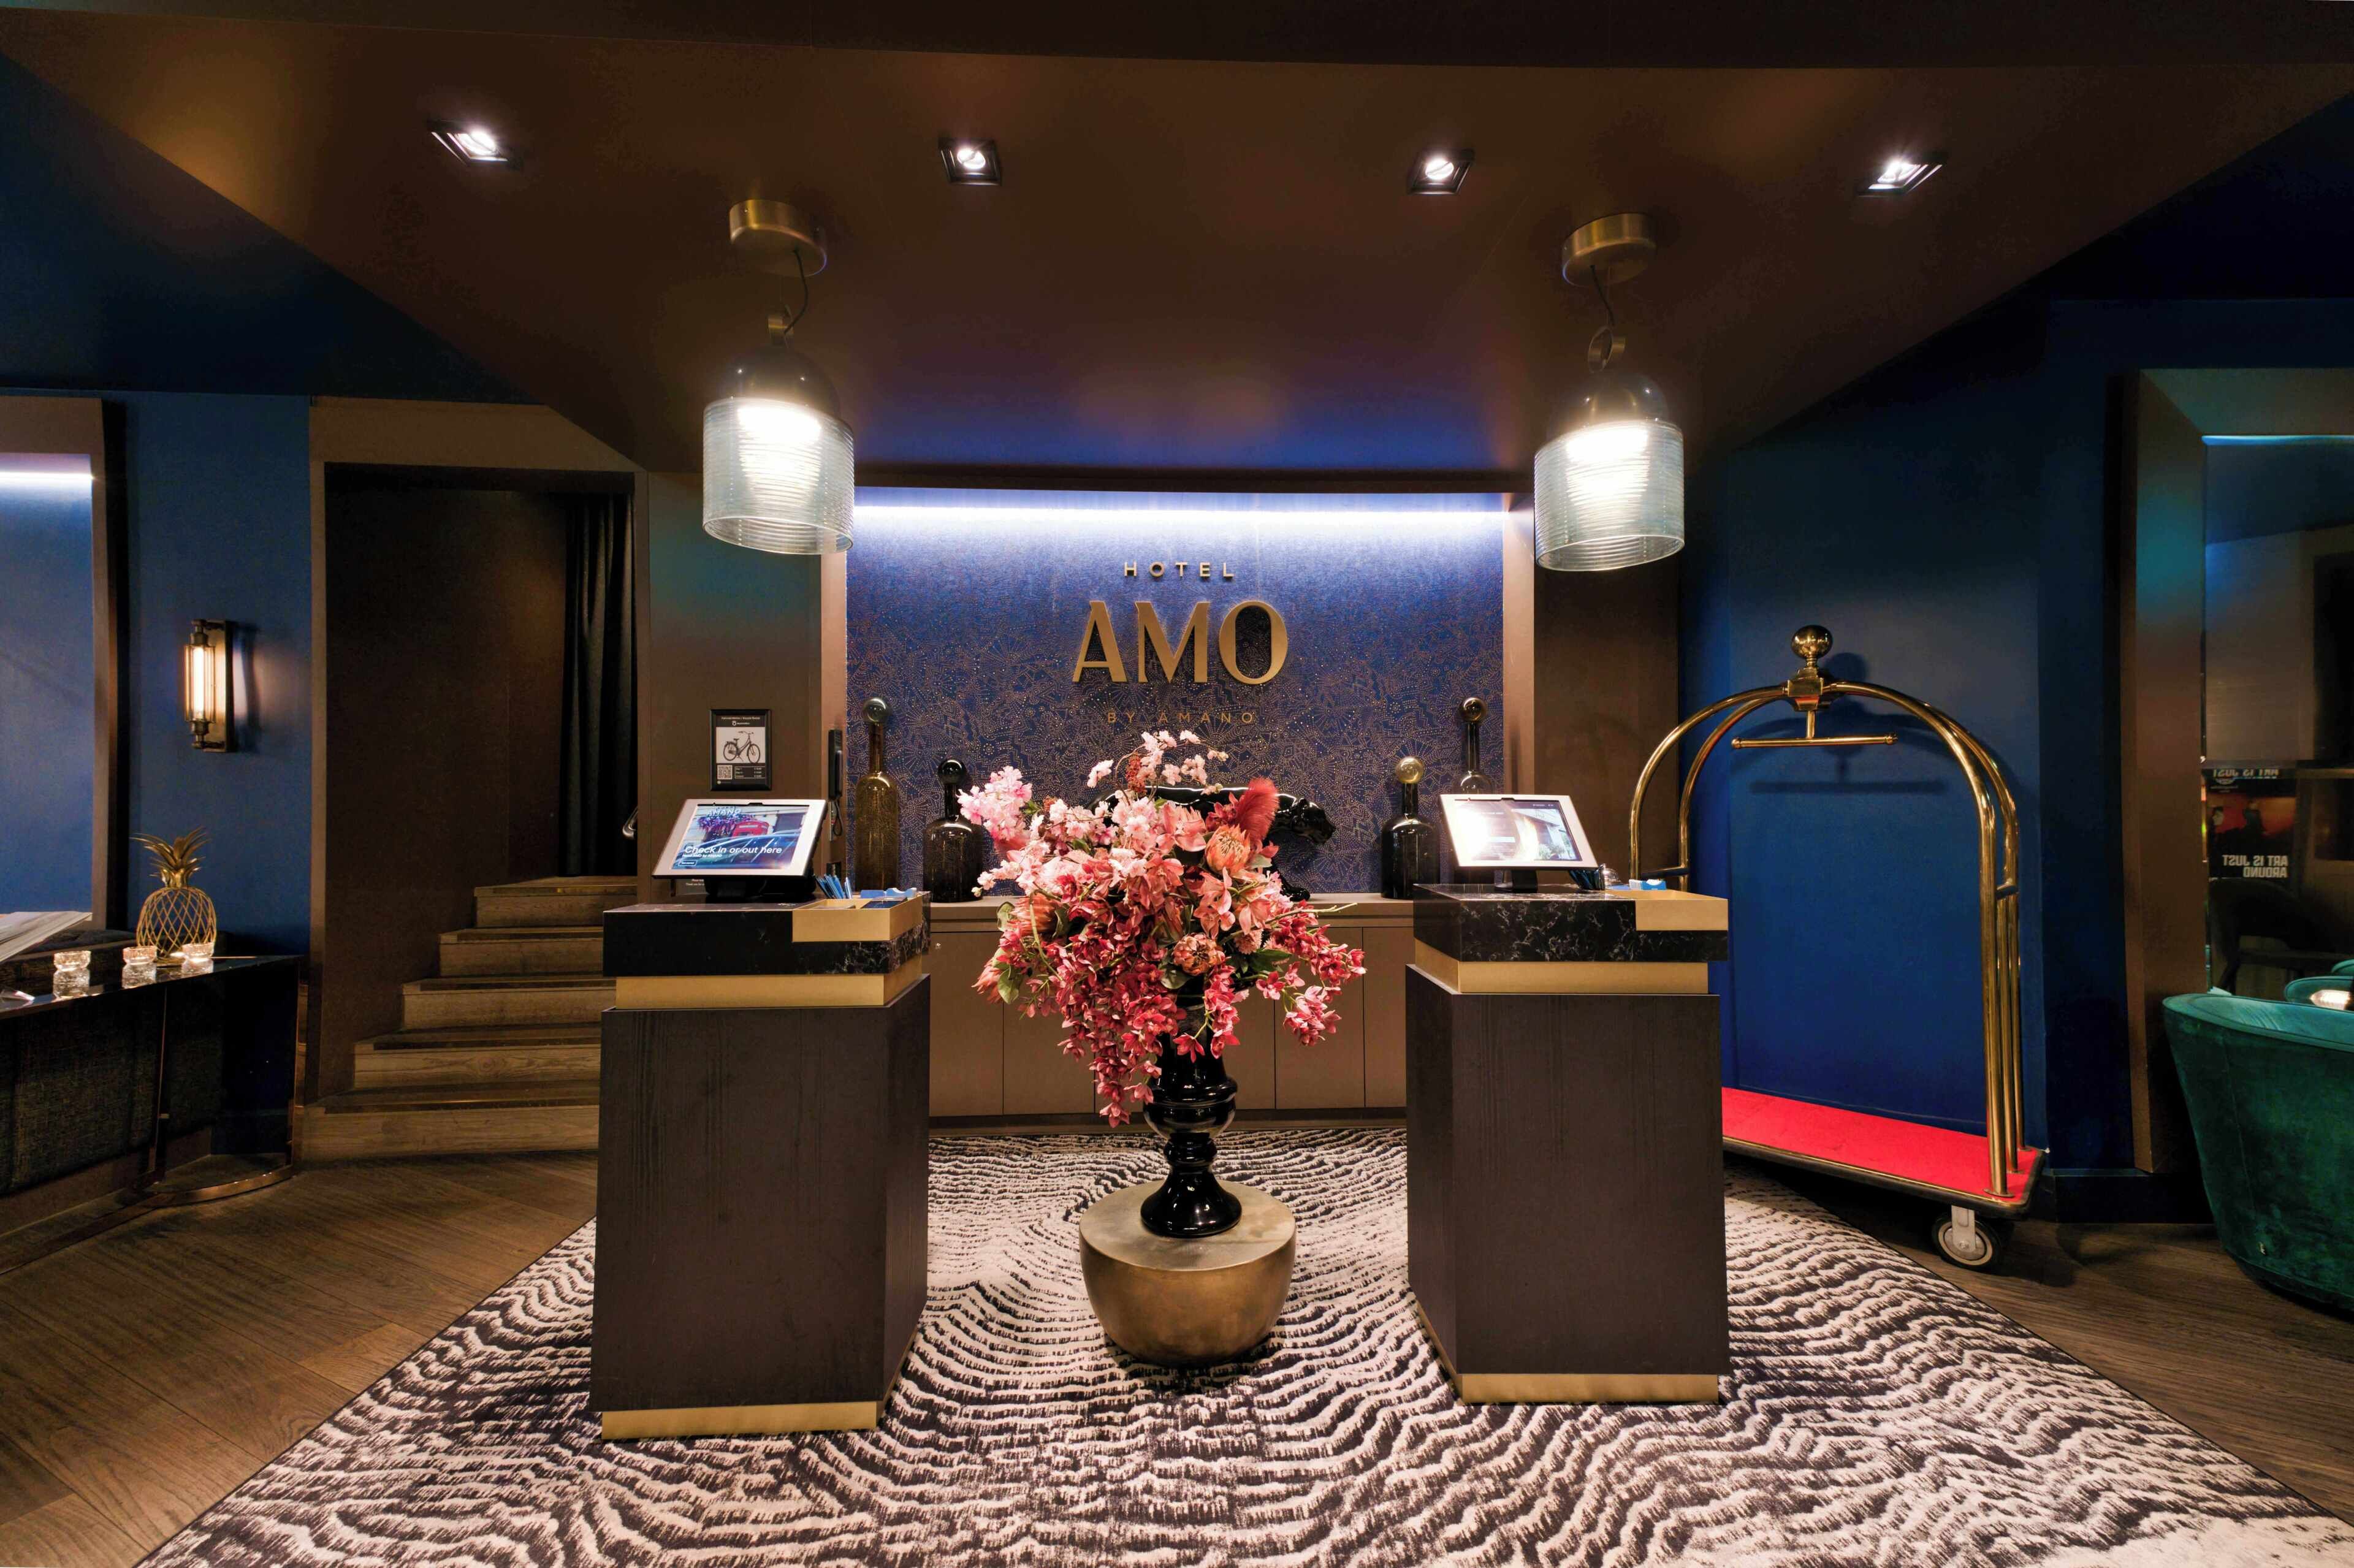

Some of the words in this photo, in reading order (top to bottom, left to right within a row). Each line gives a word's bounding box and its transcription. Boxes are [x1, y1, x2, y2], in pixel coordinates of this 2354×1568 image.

[1124, 561, 1235, 578] HOTEL
[1072, 600, 1289, 685] AMO
[1108, 712, 1135, 723] BY
[1158, 711, 1256, 724] AMANO
